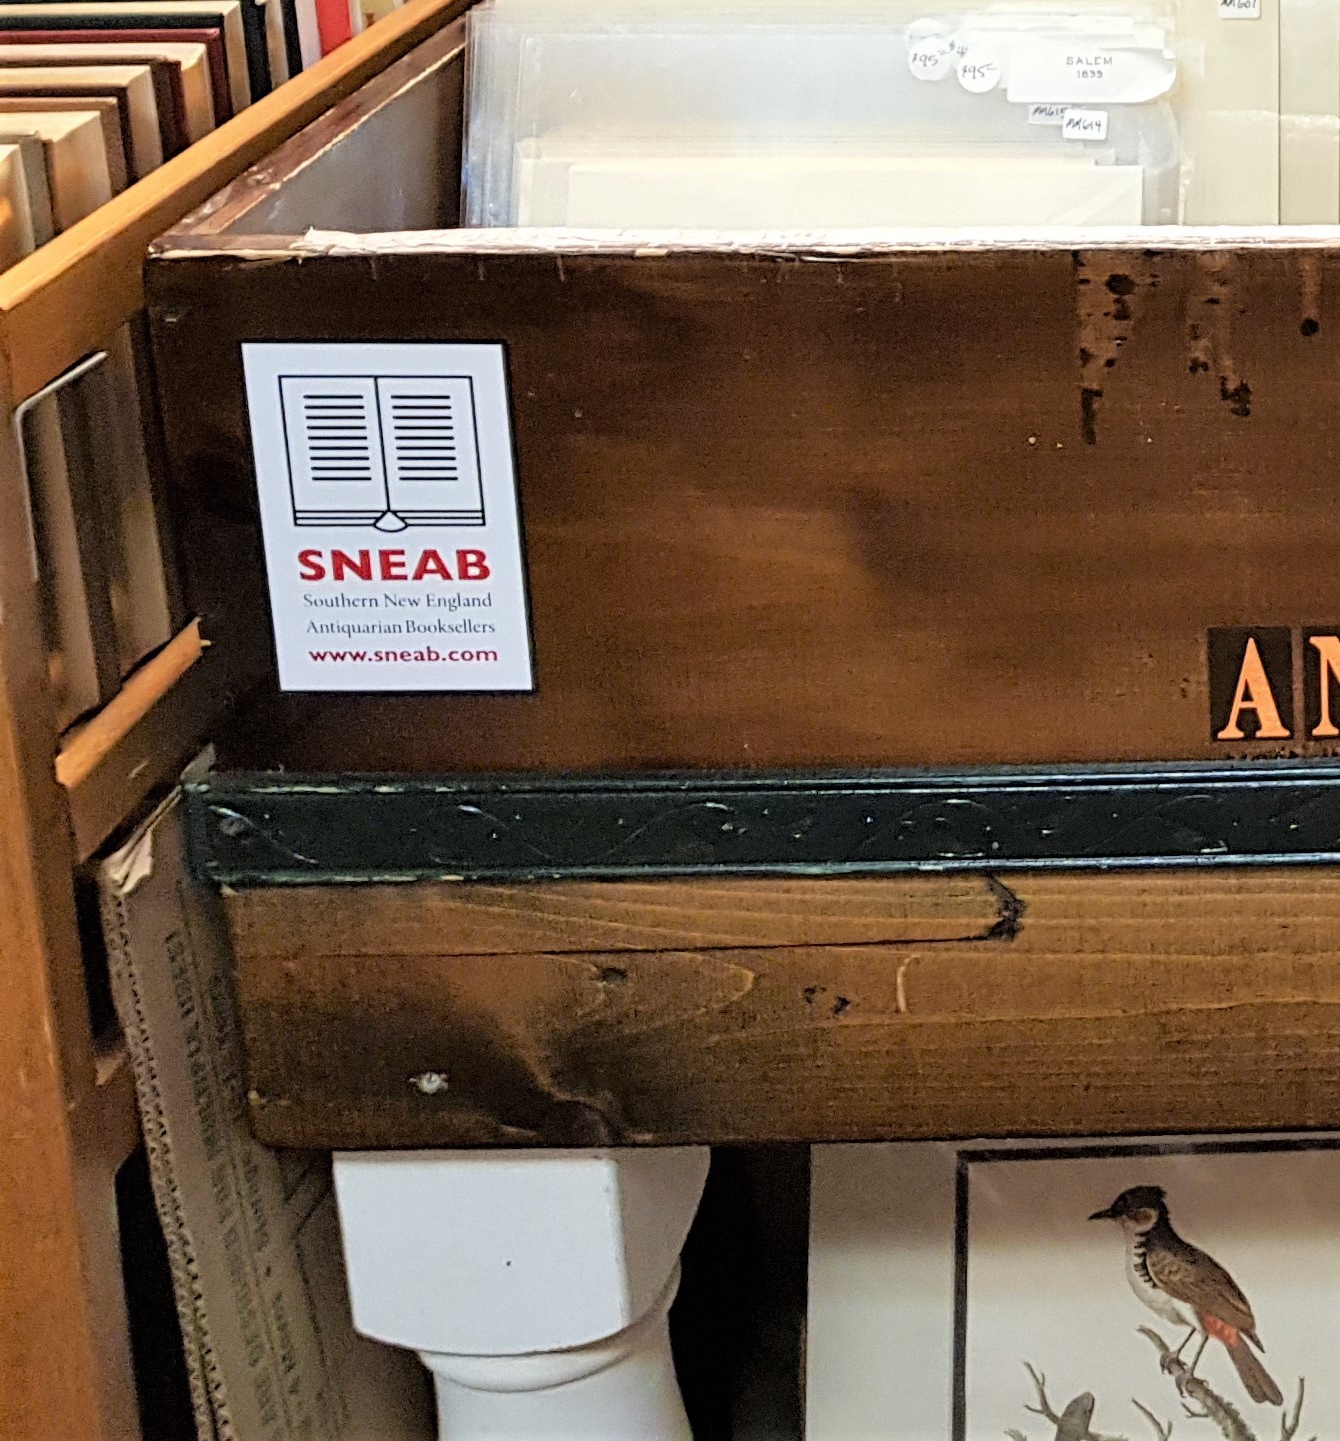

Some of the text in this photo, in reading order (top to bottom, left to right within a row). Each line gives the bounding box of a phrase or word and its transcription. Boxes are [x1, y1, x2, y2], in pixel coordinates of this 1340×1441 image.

[1065, 56, 1113, 66] SALEM
[297, 548, 492, 582] SNEAB
[303, 592, 492, 612] Southern New England
[306, 619, 496, 639] Antiquarian Booksellers
[308, 646, 499, 663] www.sneab.com
